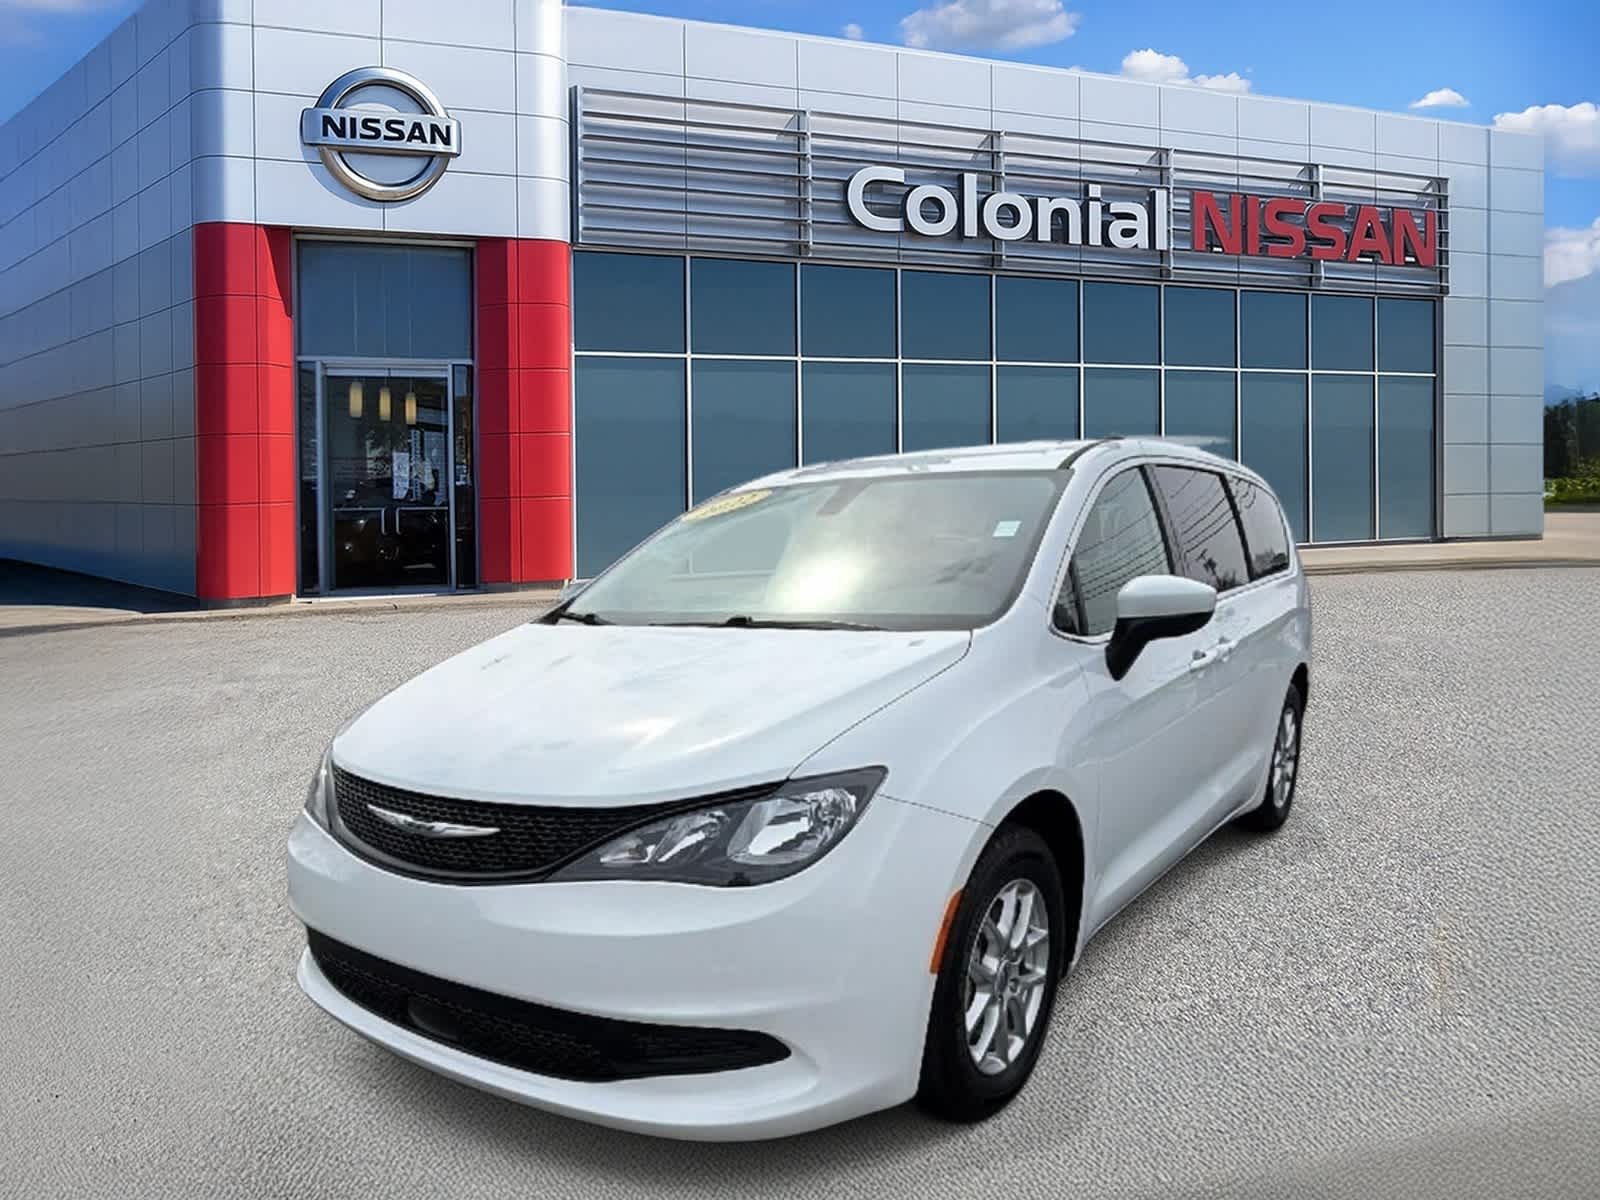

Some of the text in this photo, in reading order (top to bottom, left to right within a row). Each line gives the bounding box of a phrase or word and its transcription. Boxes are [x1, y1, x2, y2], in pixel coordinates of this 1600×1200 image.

[322, 115, 452, 146] NISSAN
[846, 166, 1436, 267] Colonial NISSAN
